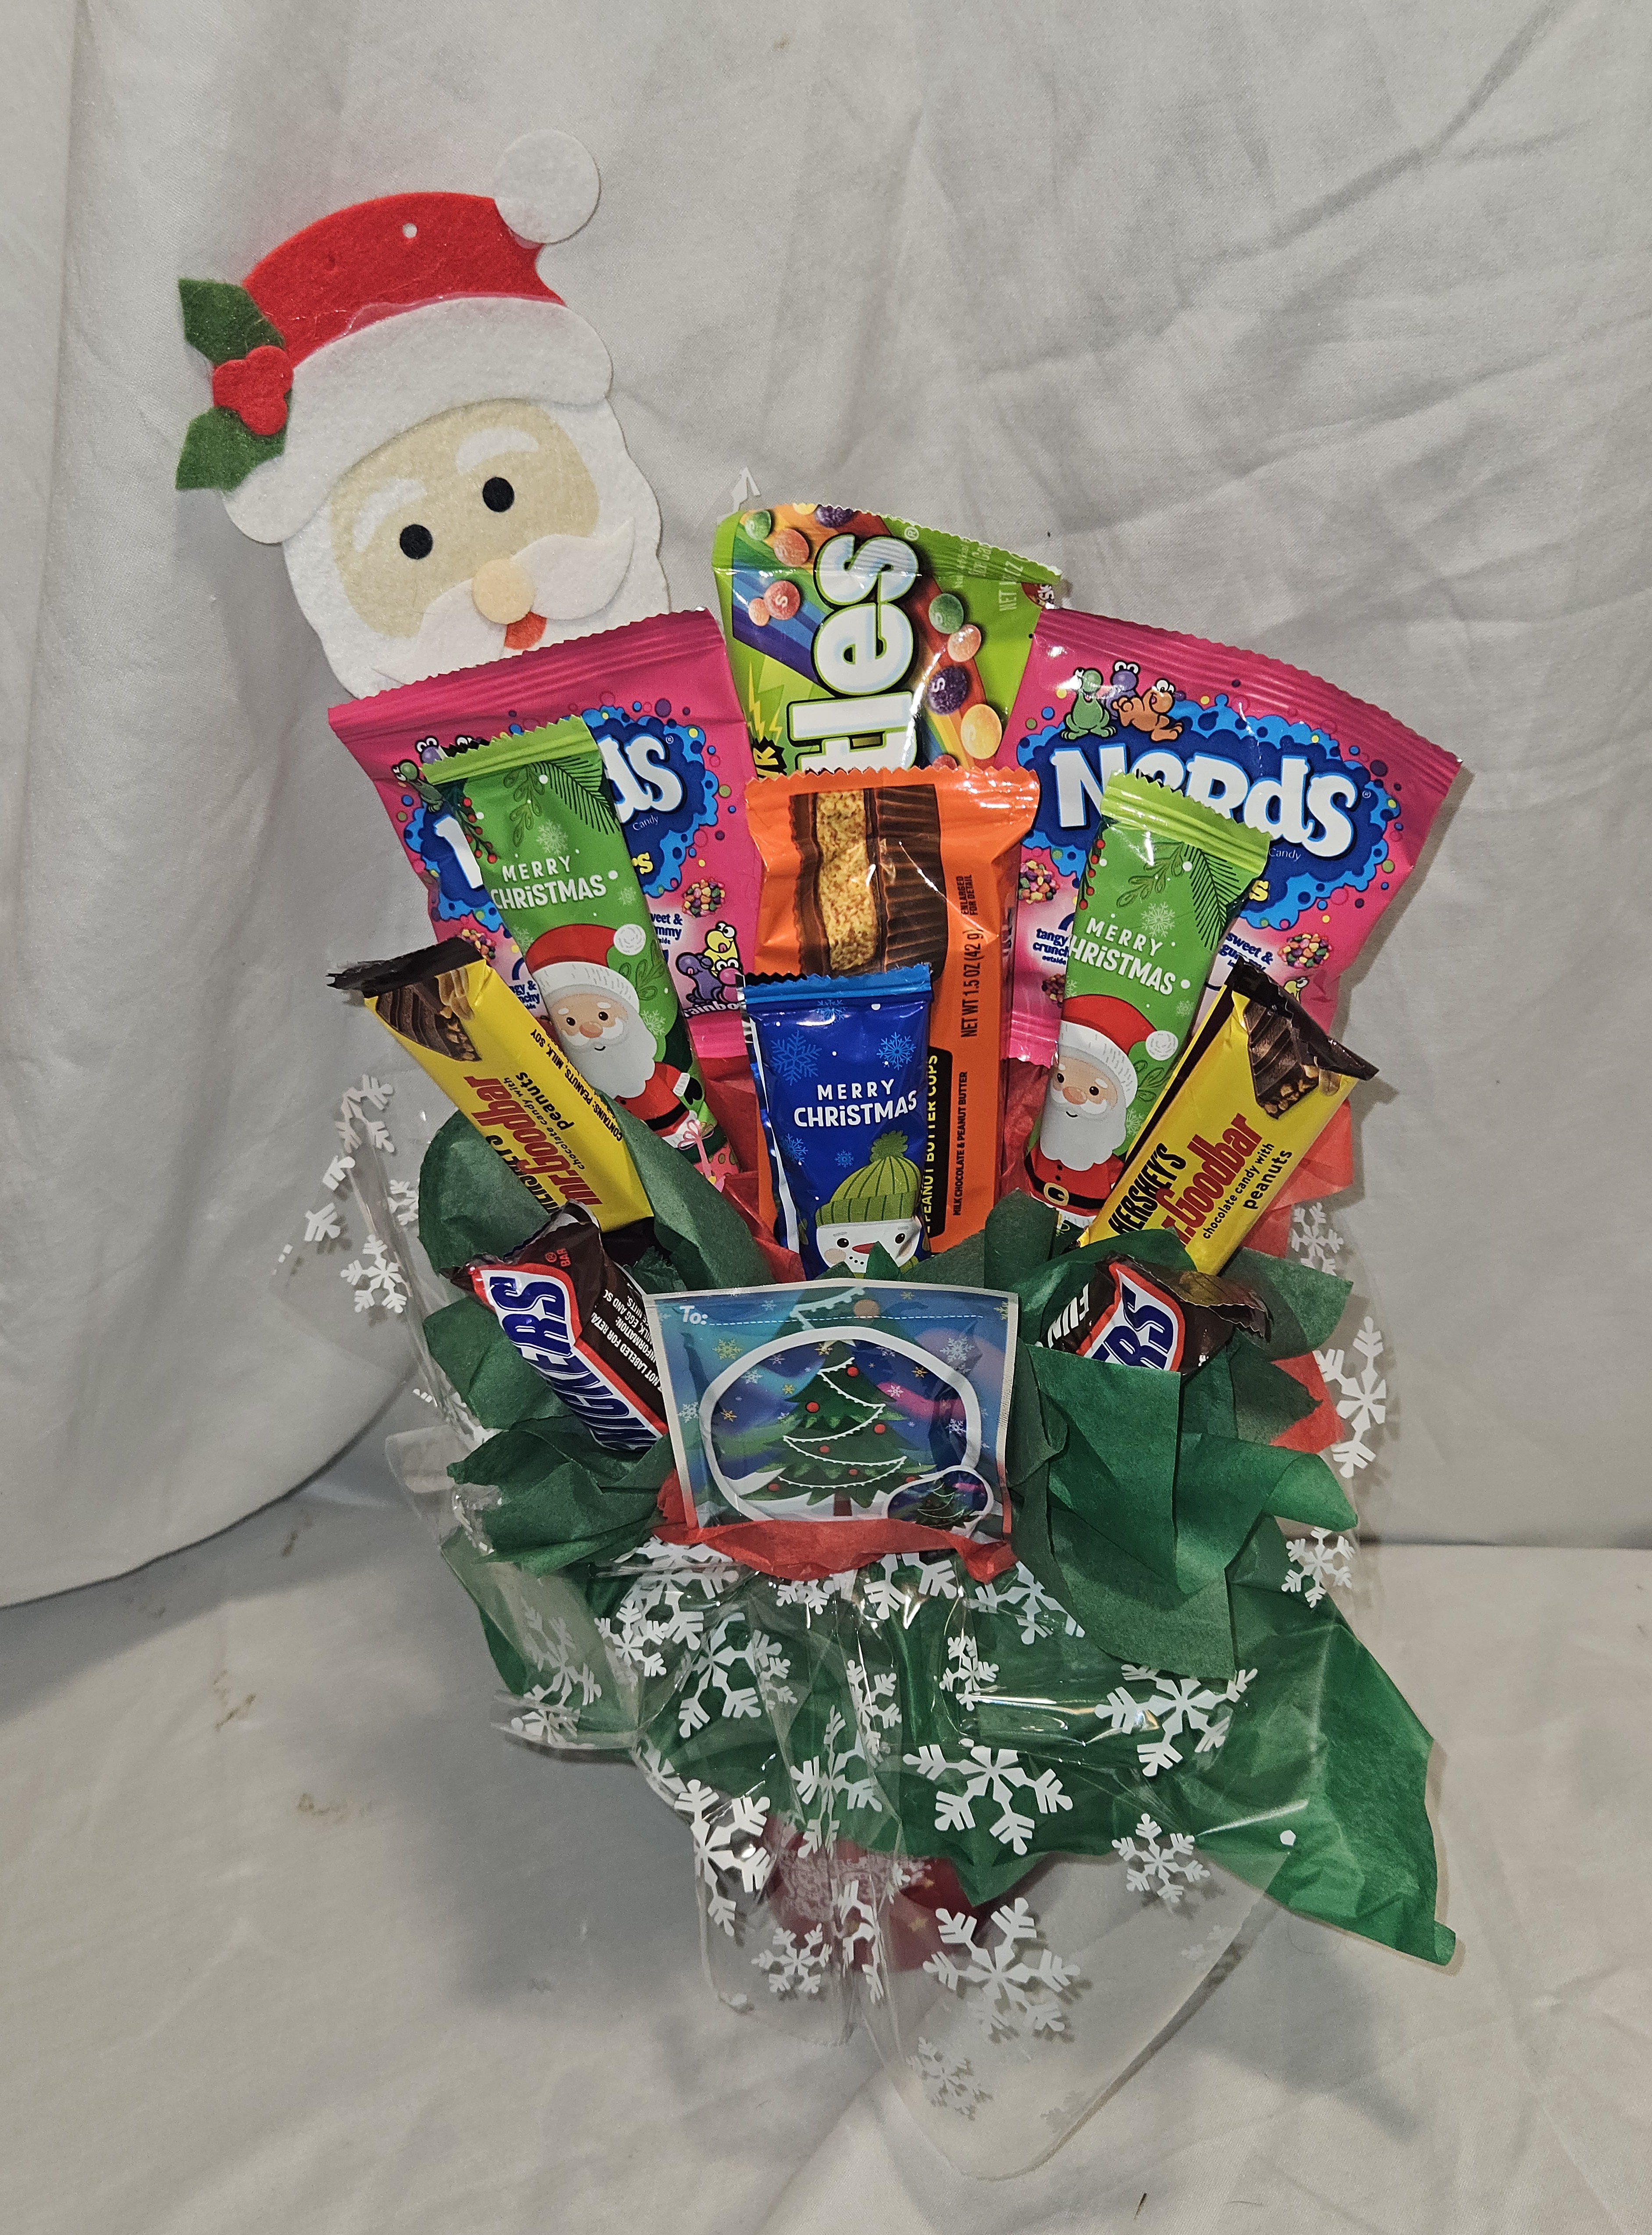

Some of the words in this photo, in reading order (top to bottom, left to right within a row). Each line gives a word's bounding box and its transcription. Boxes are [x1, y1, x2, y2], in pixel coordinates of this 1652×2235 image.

[632, 815, 659, 831] Candy
[1268, 848, 1301, 862] Candy
[502, 855, 570, 883] MERRY
[956, 875, 970, 915] ENLARGED
[964, 874, 976, 899] DETAIL
[968, 900, 979, 915] FOR
[1036, 928, 1069, 947] tangy
[1086, 917, 1163, 957] MERRY
[963, 943, 985, 961] (42
[1032, 942, 1069, 958] crunch
[1226, 932, 1262, 958] sweet
[1261, 950, 1274, 965] &
[963, 962, 980, 978] OZ
[962, 979, 979, 997] 1.5
[961, 998, 979, 1016] WT
[961, 1017, 979, 1038] NET
[530, 1029, 545, 1048] SOY
[546, 1043, 564, 1070] MILK,
[503, 1077, 523, 1098] with
[564, 1065, 593, 1106] PEANUTS,
[817, 1078, 894, 1101] MERRY
[958, 1071, 968, 1106] BUTTER
[515, 1072, 575, 1131] peanuts
[522, 1099, 548, 1125] candy
[592, 1100, 623, 1142] CONTAINS:
[957, 1106, 966, 1141] PEANUT
[546, 1127, 585, 1170] chocolate
[954, 1150, 965, 1197] CHOCOLATE
[1243, 1150, 1293, 1210] peanuts
[1203, 1195, 1238, 1239] chocolate
[1235, 1165, 1260, 1194] candy
[1254, 1143, 1275, 1165] with
[952, 1197, 962, 1216] MILK
[556, 1248, 571, 1267] BAR
[612, 1298, 627, 1315] AND
[679, 1305, 709, 1325] To:
[625, 1310, 639, 1328] EGG
[606, 1329, 622, 1348] FOR
[620, 1343, 648, 1374] LABELED
[644, 1370, 659, 1387] NOT
